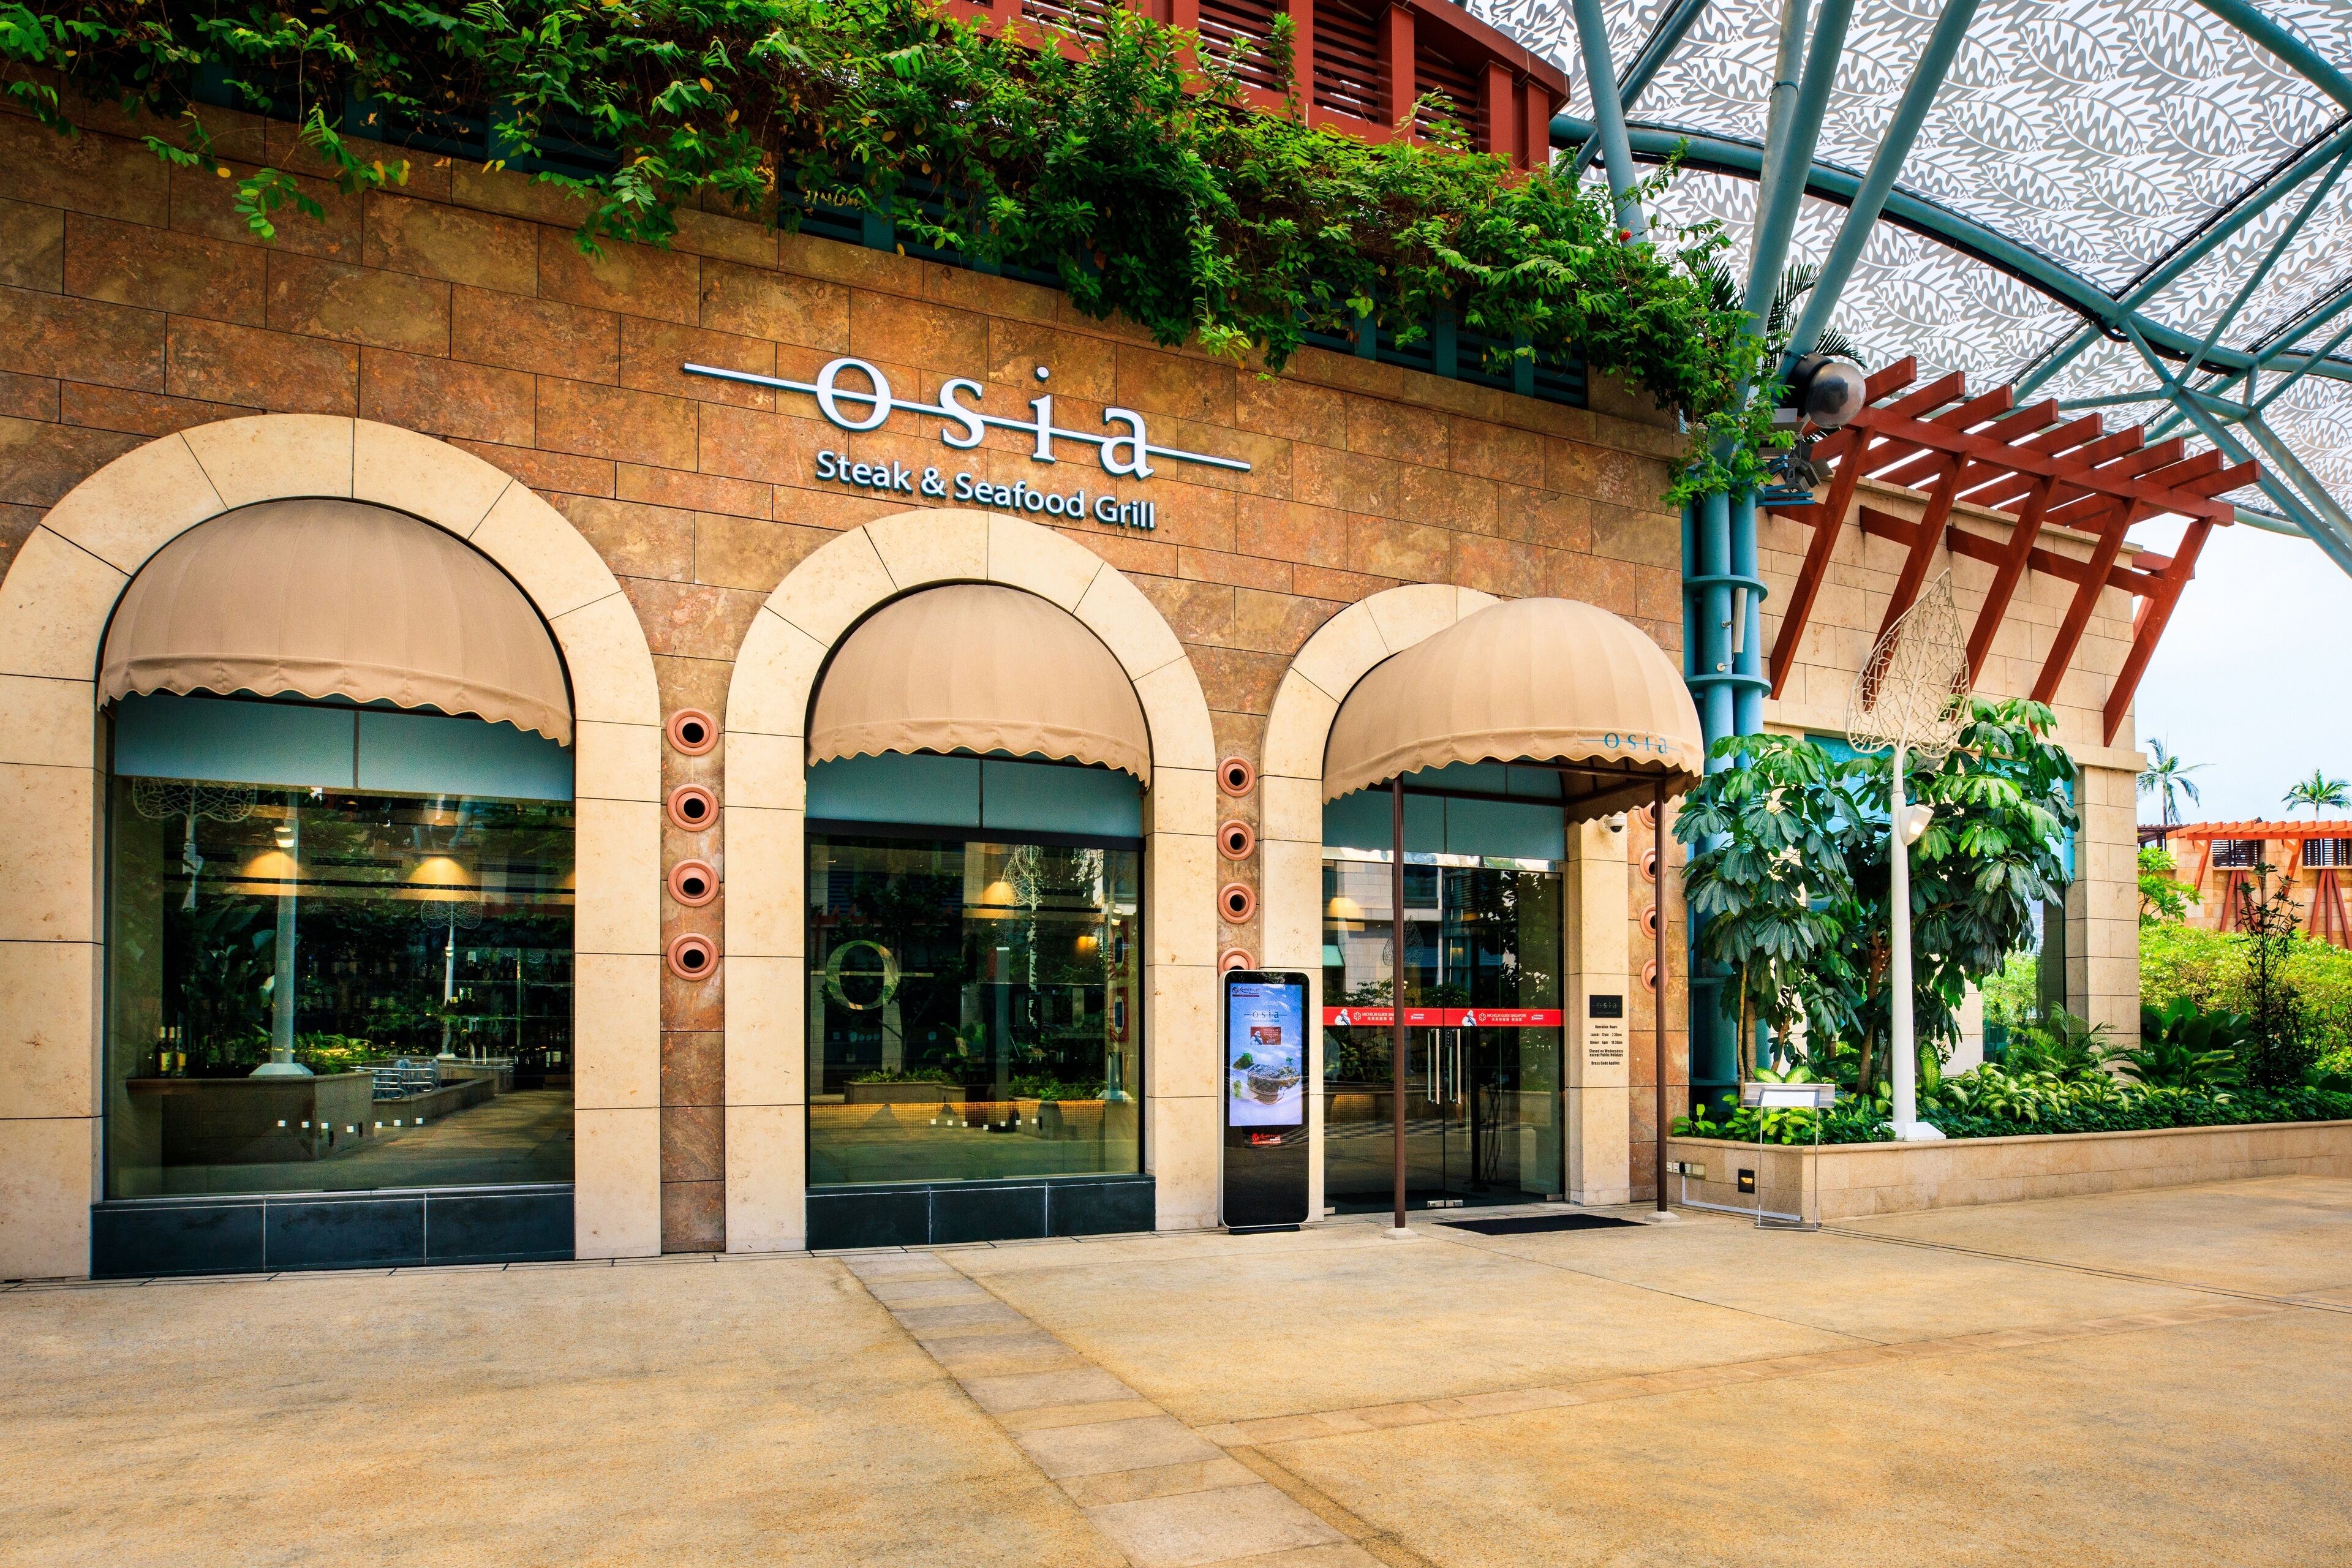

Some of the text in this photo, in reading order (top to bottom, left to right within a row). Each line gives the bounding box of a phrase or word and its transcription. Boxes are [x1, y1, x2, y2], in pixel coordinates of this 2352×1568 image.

[816, 450, 1155, 531] Steak & Seafood Grill
[1253, 1009, 1279, 1018] osia
